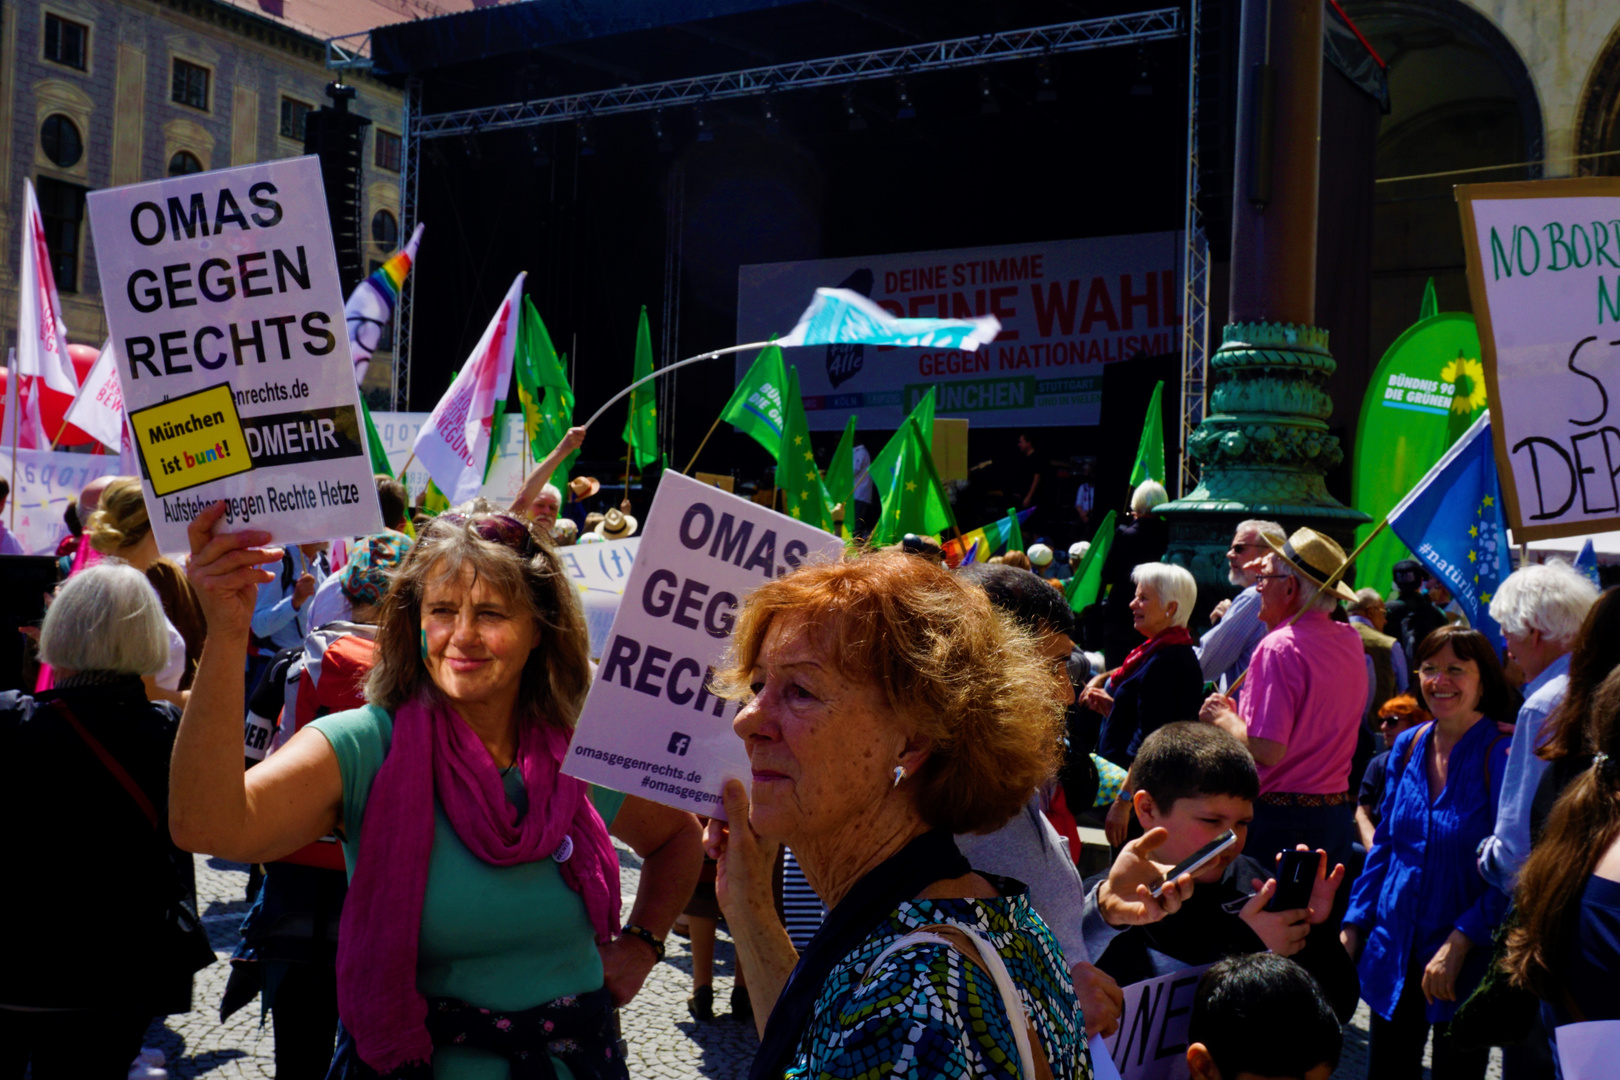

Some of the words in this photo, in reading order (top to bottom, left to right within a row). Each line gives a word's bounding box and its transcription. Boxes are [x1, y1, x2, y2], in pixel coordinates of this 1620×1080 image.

[130, 181, 283, 246] OMAS
[1490, 225, 1540, 281] NO
[126, 246, 311, 313] GEGEN
[885, 265, 946, 294] DEINE
[952, 254, 1044, 286] STIMME
[1031, 269, 1184, 339] WAHL
[125, 311, 336, 380] RECHTS
[919, 347, 990, 377] GEGEN
[999, 334, 1183, 370] NATIONALISMU
[748, 392, 771, 410] DIE
[834, 396, 857, 407] KÖLN
[911, 381, 1026, 412] MÜNCHEN
[1038, 379, 1094, 393] STUTTGART
[1384, 387, 1404, 401] DIE
[1406, 390, 1453, 408] GRÜNEN
[1388, 372, 1438, 392] BÜNDNIS
[1440, 383, 1456, 395] 90
[148, 411, 225, 444] München
[160, 456, 182, 475] ist
[183, 440, 231, 469] bunt!
[223, 492, 266, 524] gegen
[267, 481, 317, 514] Rechte
[318, 480, 359, 505] Hetze
[679, 502, 808, 579] OMAS
[642, 568, 738, 639] GEG
[602, 634, 743, 719] RECH
[575, 745, 702, 783] omasgegenrechts.de
[640, 775, 725, 805] #omasgegenr
